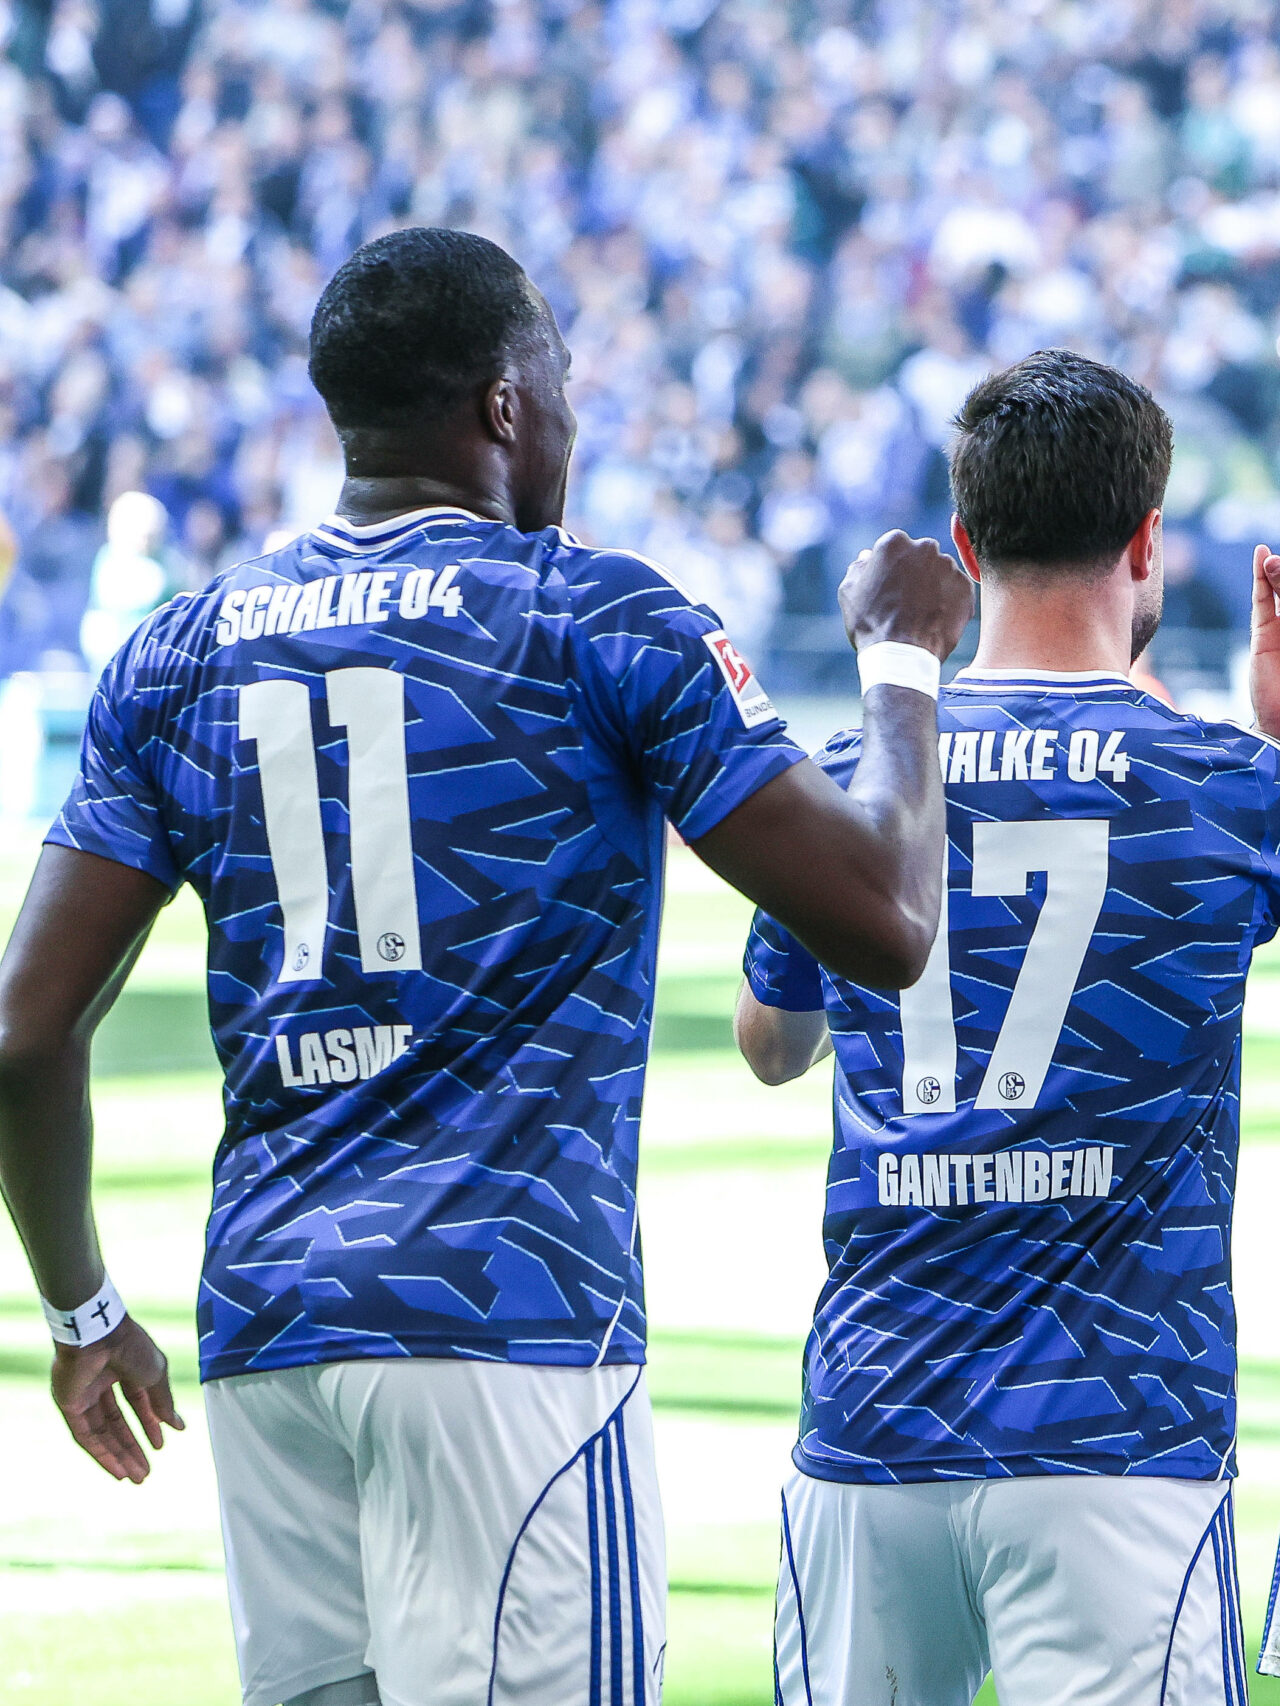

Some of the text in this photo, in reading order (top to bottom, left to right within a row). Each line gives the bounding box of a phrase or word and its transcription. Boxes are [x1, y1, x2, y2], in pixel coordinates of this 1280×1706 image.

[216, 564, 463, 647] SCHALKE 04
[1067, 729, 1131, 783] 04
[238, 667, 423, 984] 11
[900, 820, 1109, 1114] 17
[877, 1146, 1114, 1207] GANTENBEIN
